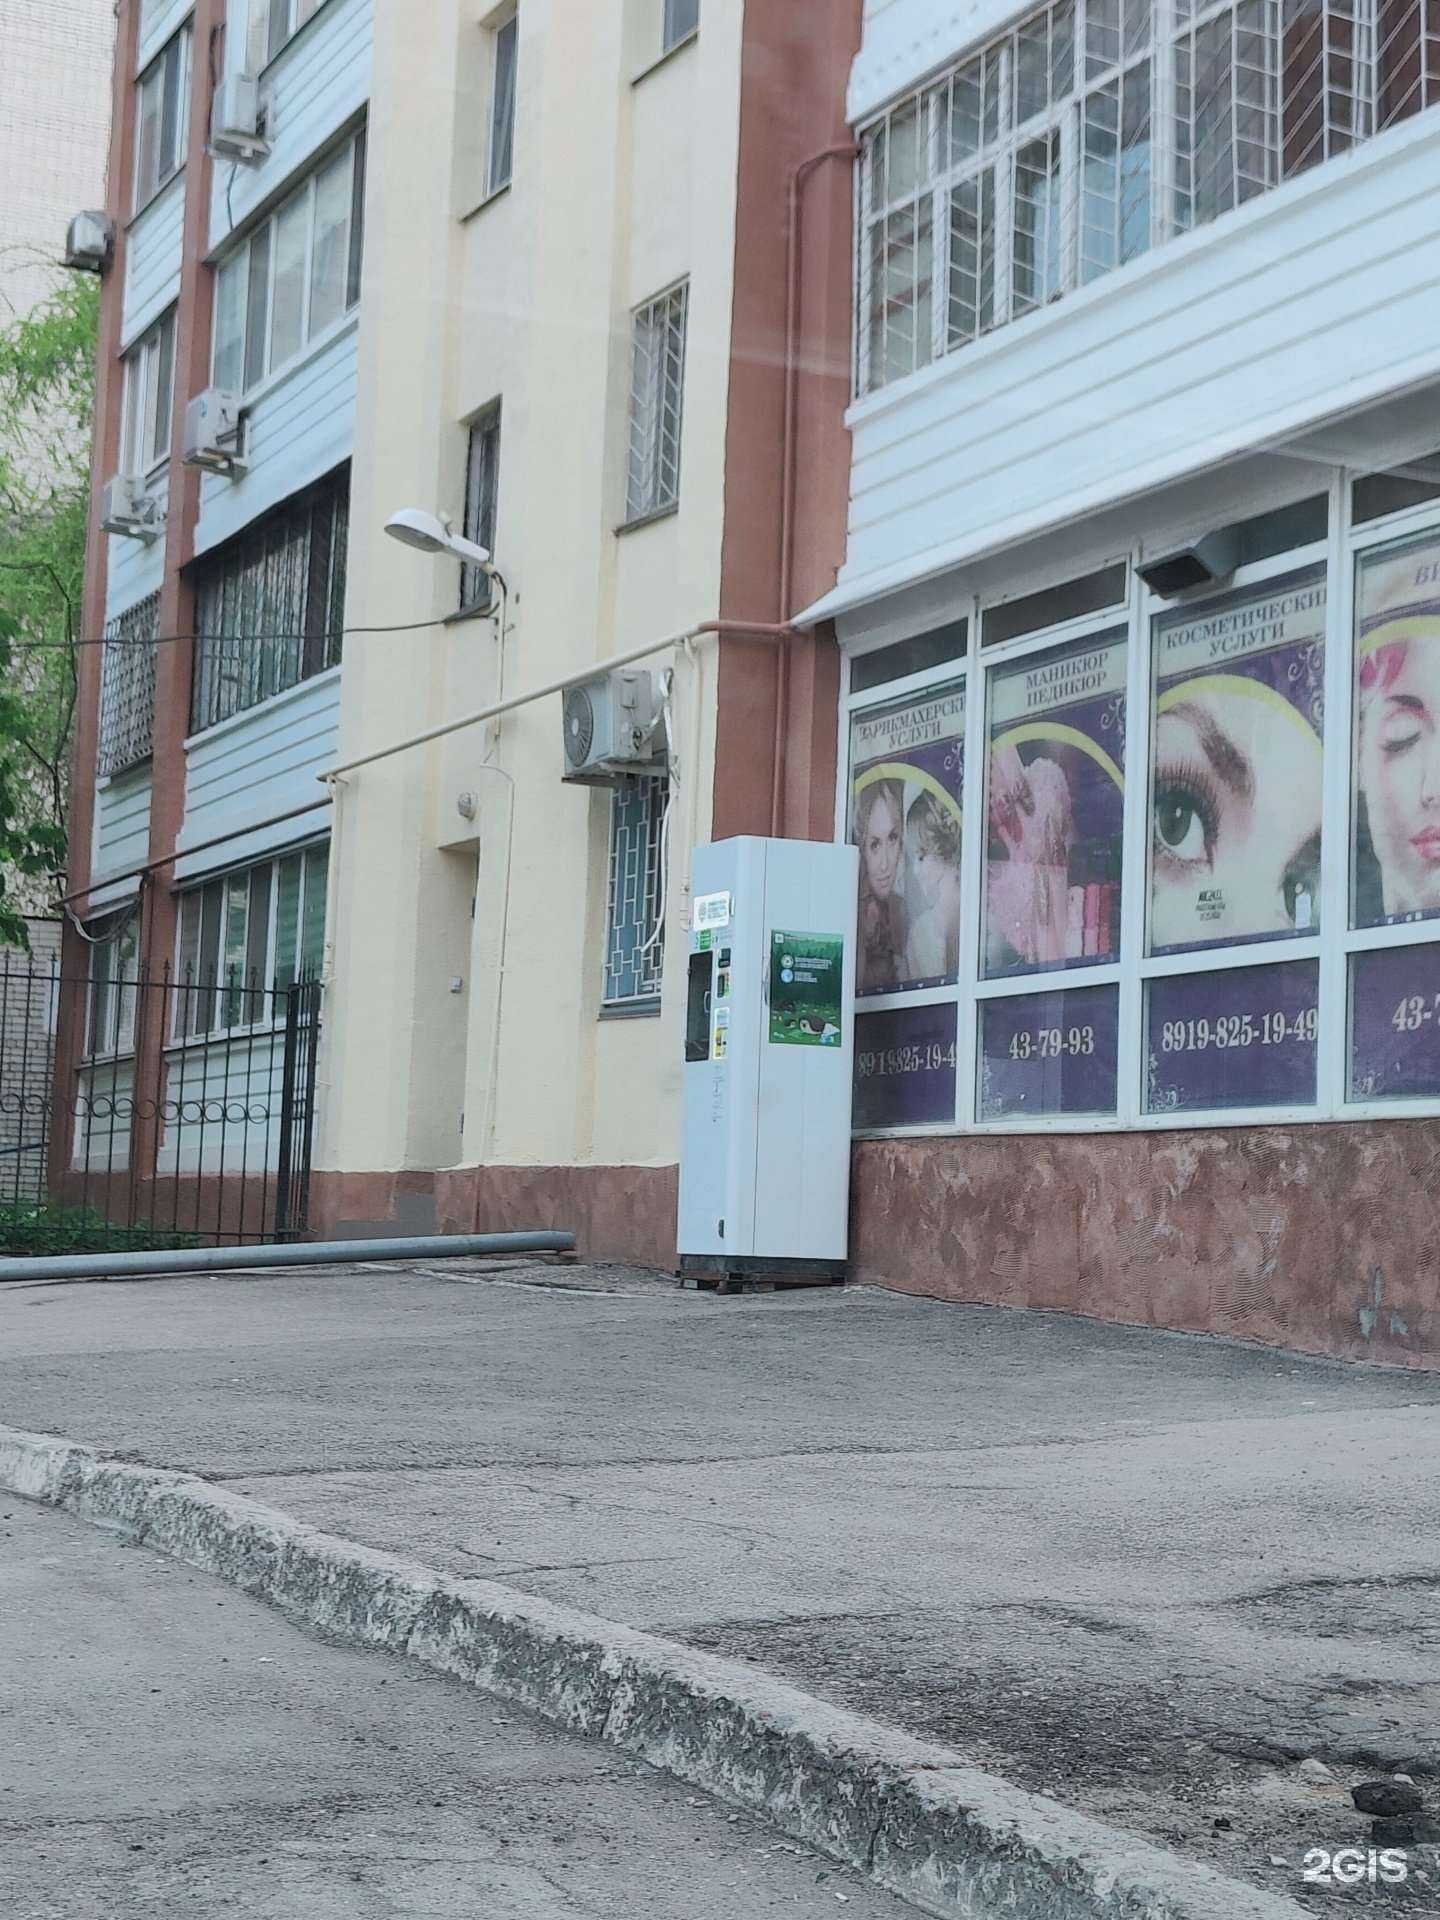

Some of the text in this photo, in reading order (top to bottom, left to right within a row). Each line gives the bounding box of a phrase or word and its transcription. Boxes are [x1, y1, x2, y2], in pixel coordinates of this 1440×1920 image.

[1209, 622, 1285, 657] УСЛУГИ
[1026, 652, 1109, 690] МАНИКЮР
[1027, 671, 1107, 707] ПЕДИКЮР
[889, 719, 941, 749] УСЛУГИ
[1009, 1025, 1095, 1060] 43-79-93
[1162, 1007, 1319, 1052] 8919-825-19-49
